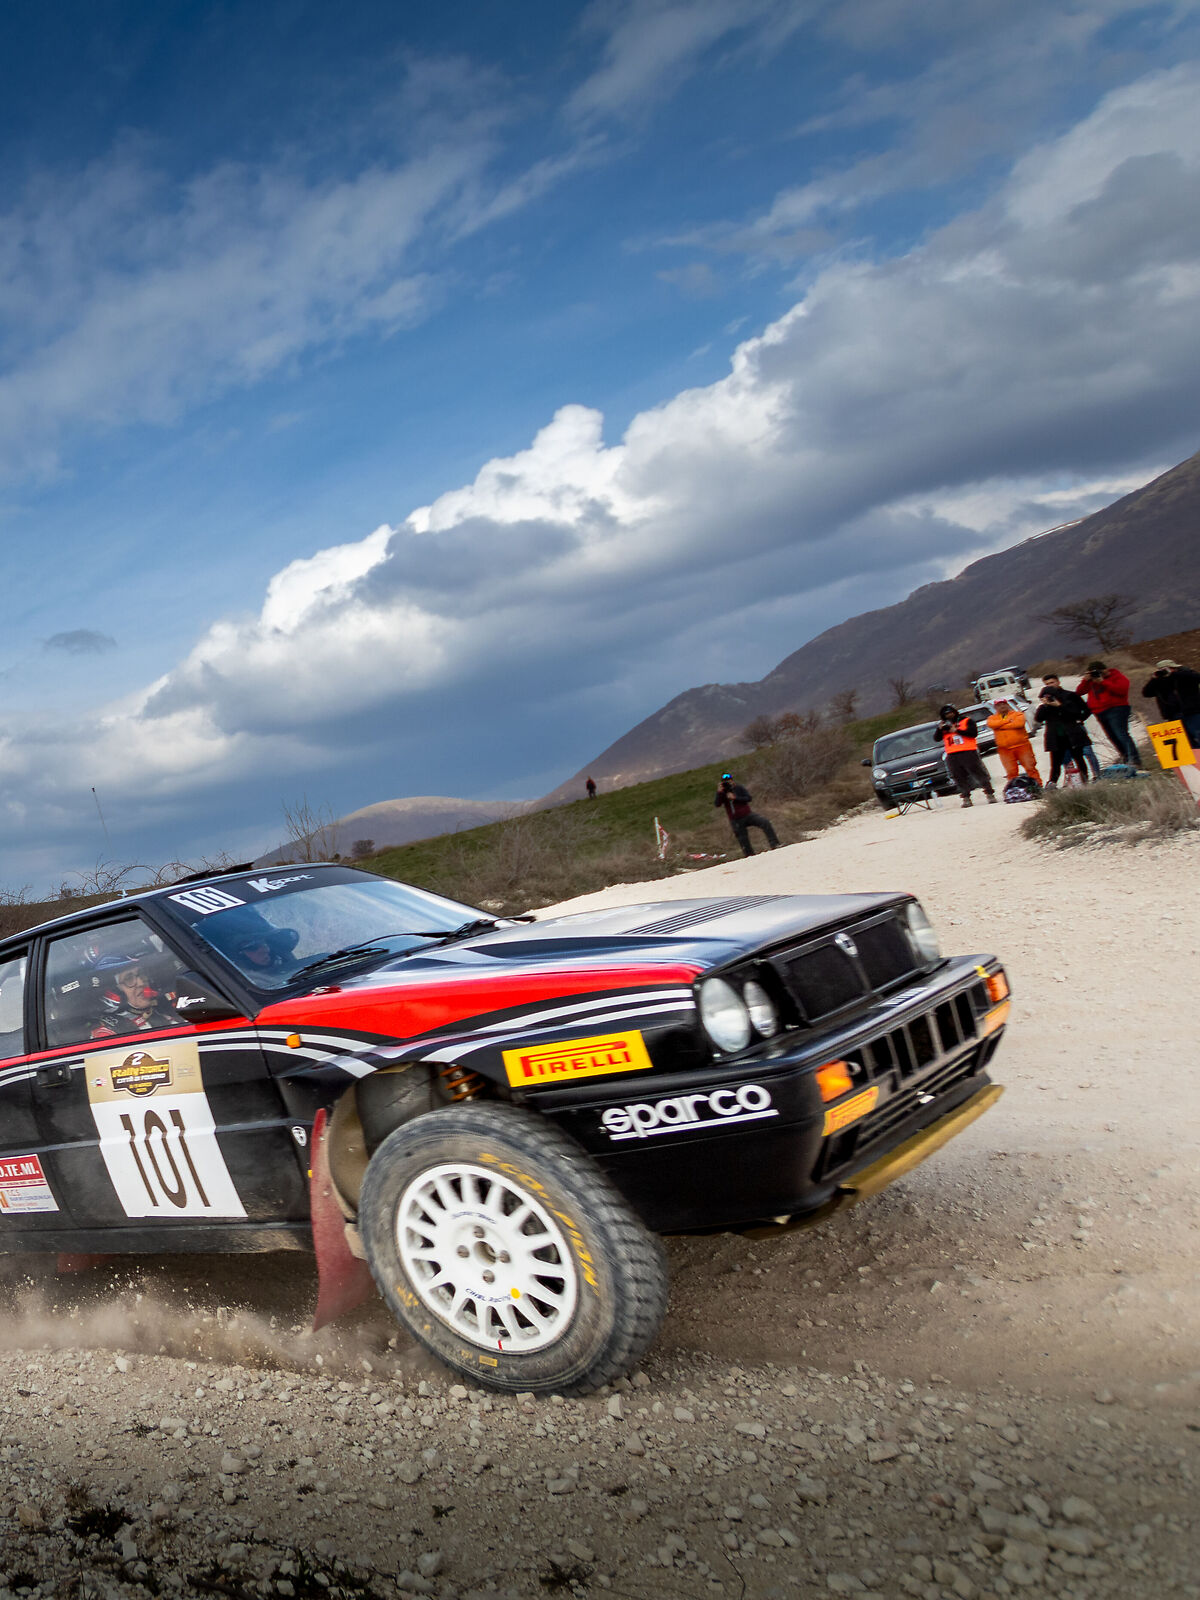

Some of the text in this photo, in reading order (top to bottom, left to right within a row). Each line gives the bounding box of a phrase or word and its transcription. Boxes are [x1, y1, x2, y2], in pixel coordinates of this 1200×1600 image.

[1162, 738, 1179, 761] 7
[179, 888, 238, 912] 101
[131, 1053, 145, 1065] 2
[520, 1040, 633, 1078] PIRELLI
[601, 1084, 772, 1138] sparco
[120, 1109, 212, 1209] 101
